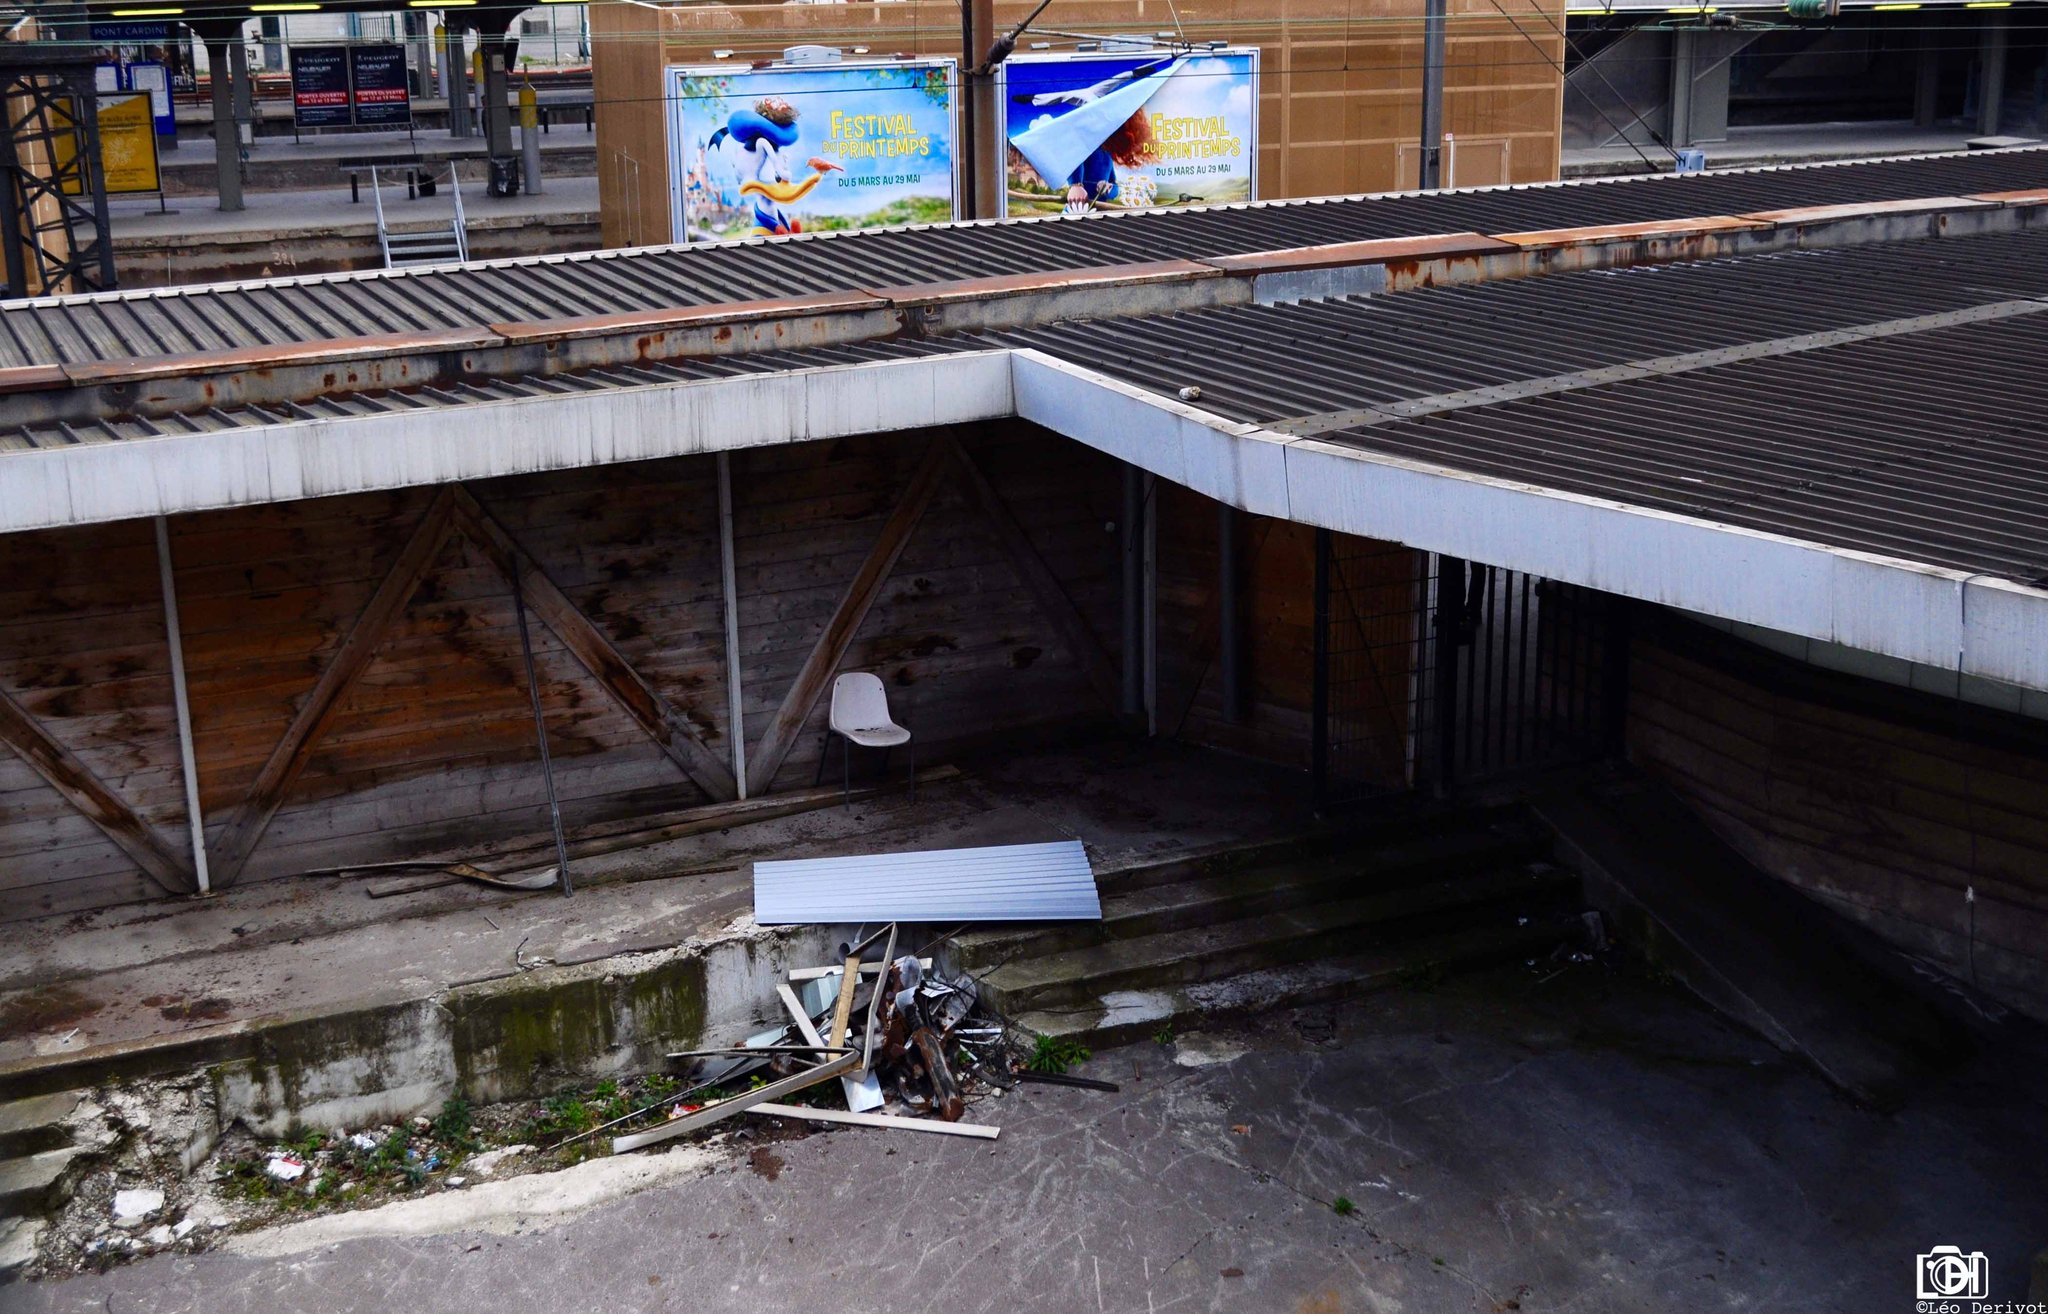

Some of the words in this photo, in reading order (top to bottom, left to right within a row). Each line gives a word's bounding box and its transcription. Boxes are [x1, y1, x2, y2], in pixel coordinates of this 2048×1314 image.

[94, 26, 121, 36] PONT
[831, 110, 917, 139] FESTIVAL
[1151, 112, 1230, 141] FESTIVAL
[822, 141, 837, 153] DU
[839, 136, 929, 159] PRINTEMPS
[1143, 142, 1156, 154] DU
[1158, 137, 1241, 160] PRINTEMPS
[838, 178, 849, 187] DU
[851, 176, 857, 187] 5
[858, 175, 881, 186] MARS
[882, 175, 894, 186] AU
[895, 175, 905, 184] 29
[906, 174, 921, 183] MAI
[1156, 167, 1166, 176] DU
[1168, 167, 1173, 176] 5
[1174, 165, 1195, 176] MARS
[1196, 165, 1207, 174] AU
[1208, 165, 1217, 173] 29
[1218, 164, 1231, 173] MAI
